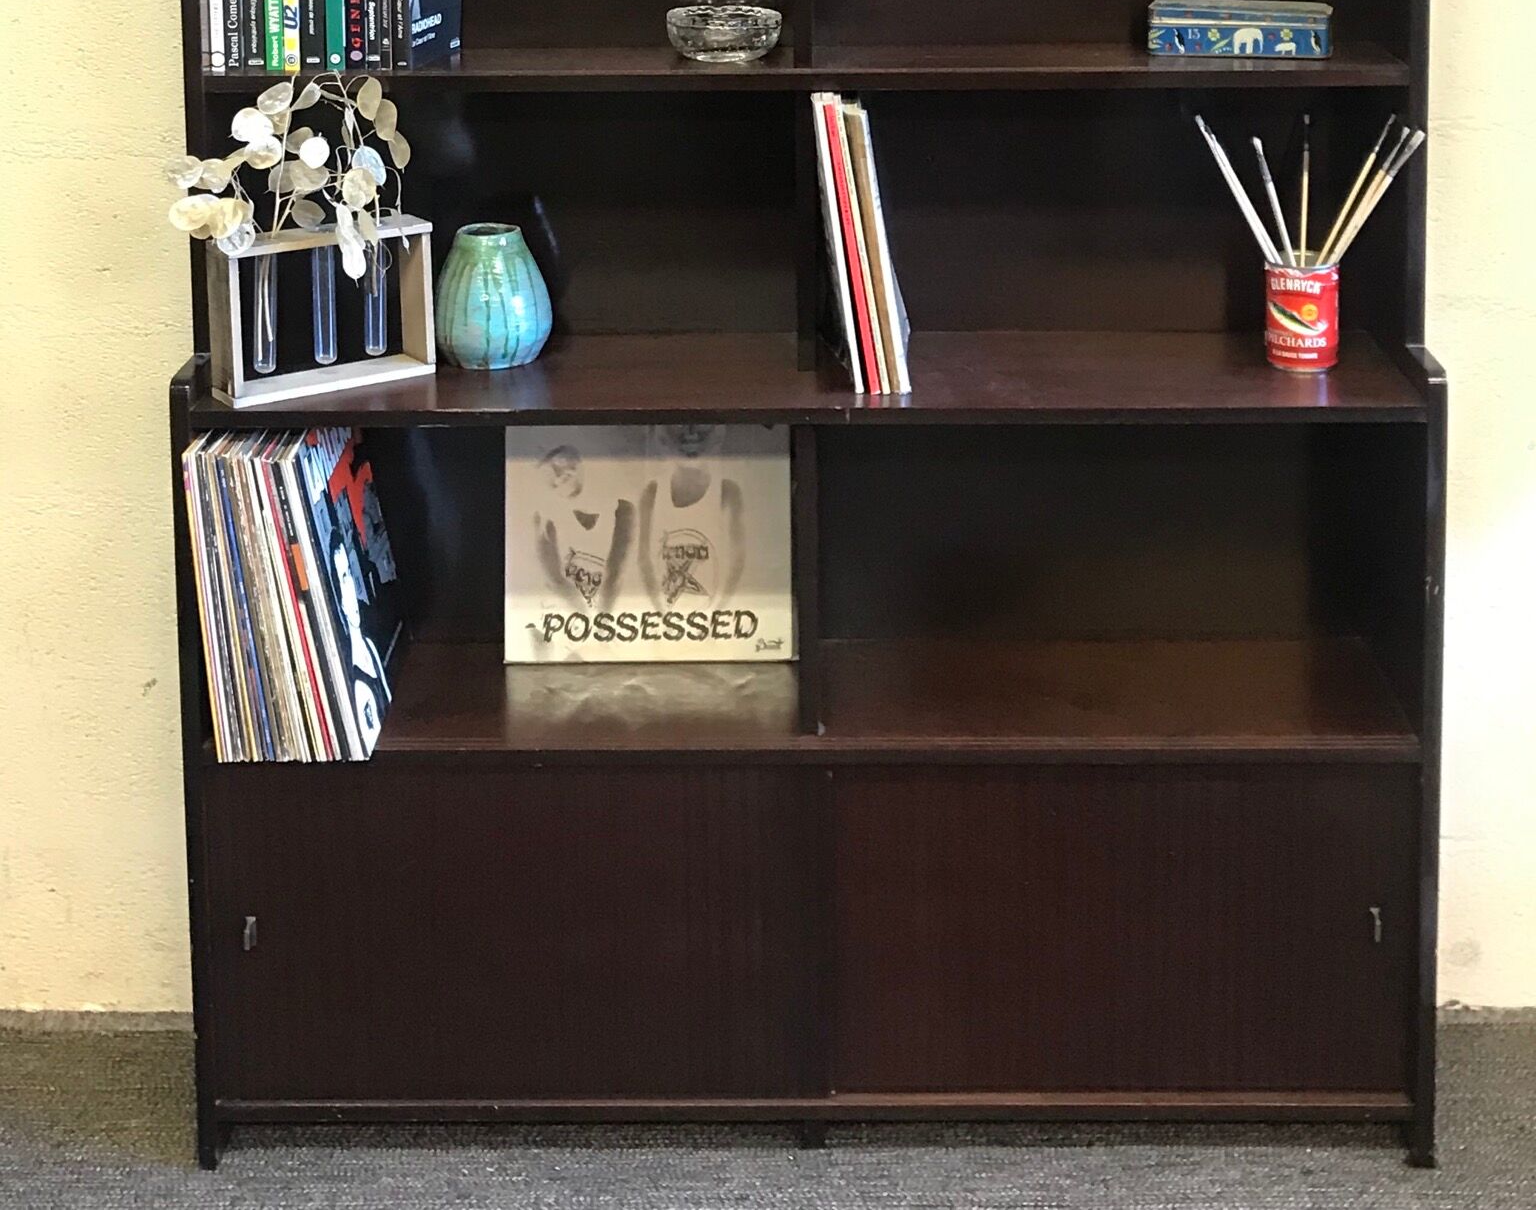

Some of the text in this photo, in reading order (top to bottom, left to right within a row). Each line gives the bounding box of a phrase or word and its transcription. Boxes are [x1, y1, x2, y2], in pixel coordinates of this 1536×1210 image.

[284, 4, 298, 30] U2
[367, 0, 376, 41] Septentrion
[411, 13, 442, 35] RADIOHEAD
[227, 32, 239, 67] Pascal
[271, 35, 279, 67] Robert
[1270, 277, 1321, 295] GLENRYCK
[542, 610, 759, 642] POSSESSED
